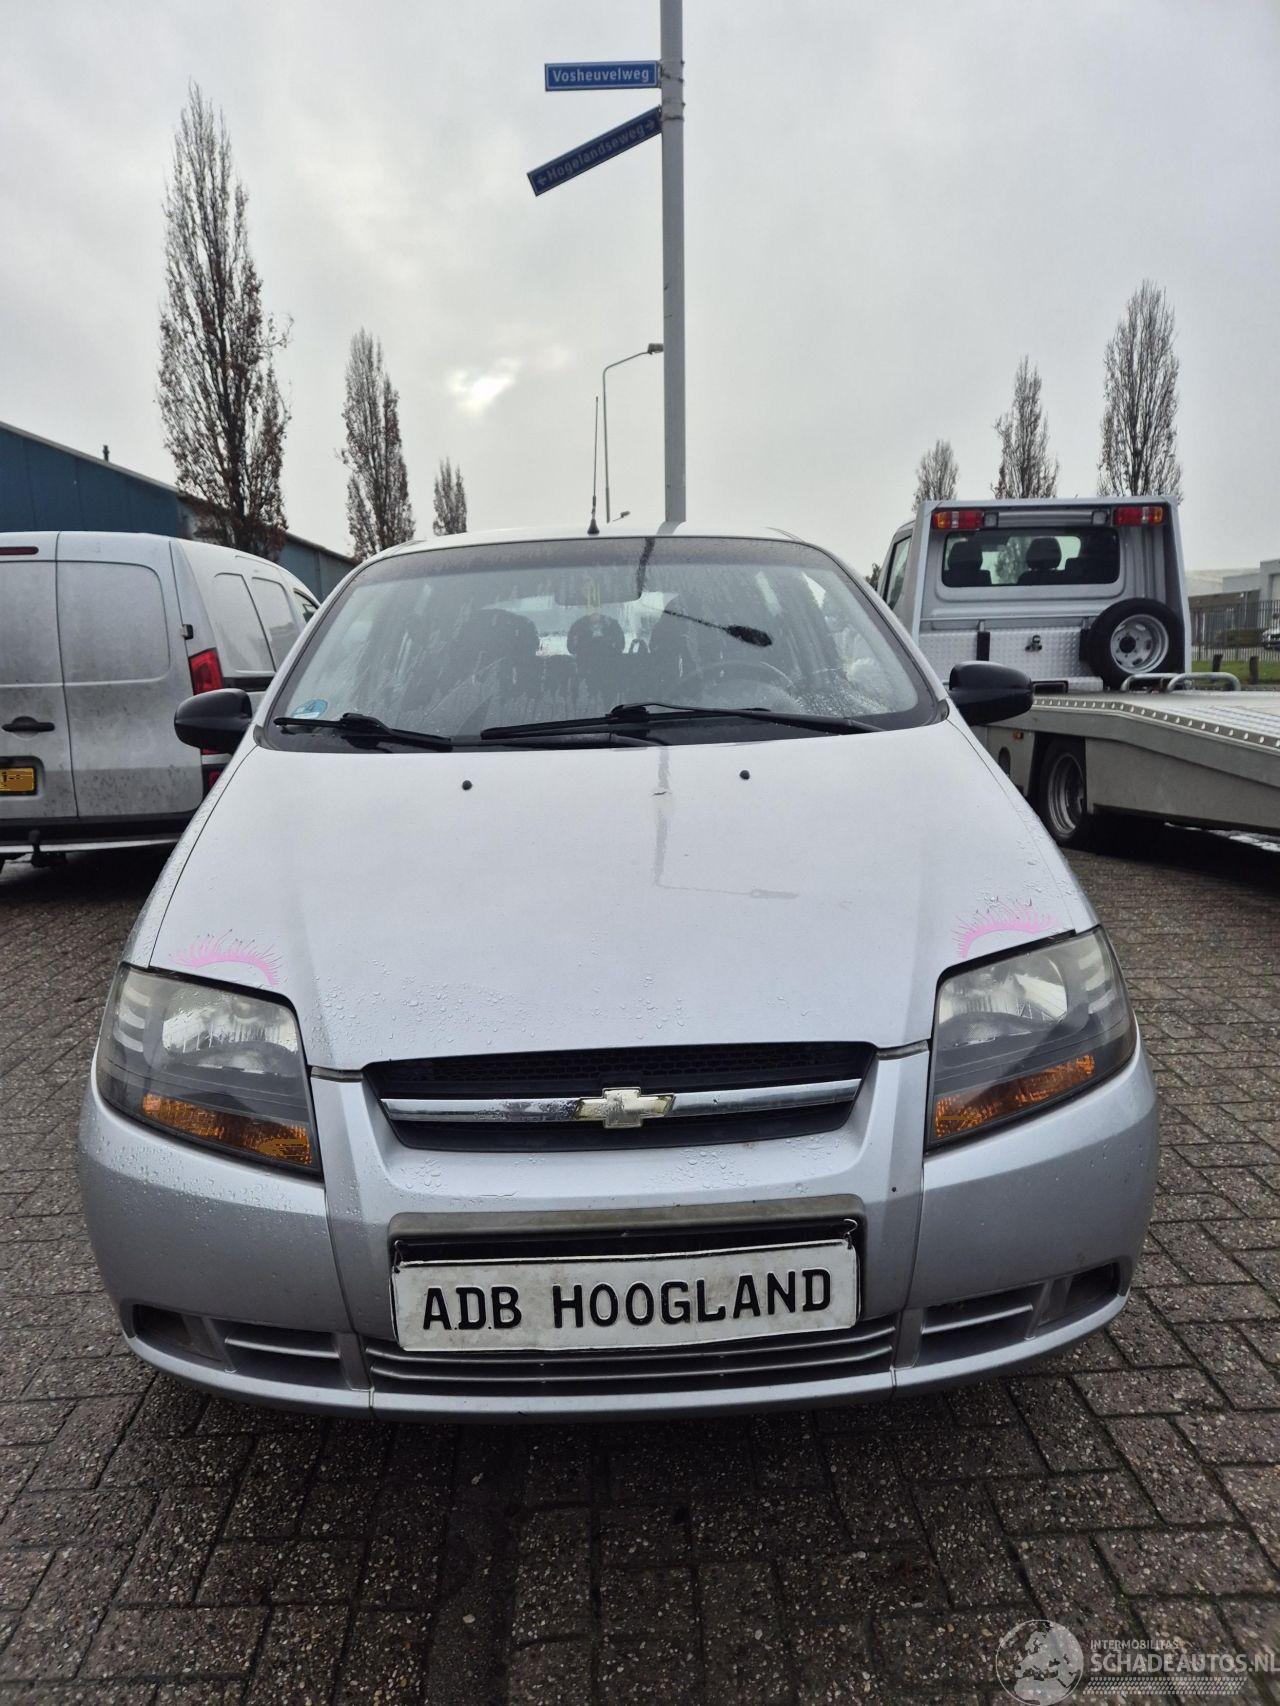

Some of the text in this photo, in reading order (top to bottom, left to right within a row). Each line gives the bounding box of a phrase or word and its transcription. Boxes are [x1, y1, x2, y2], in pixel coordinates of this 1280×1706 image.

[552, 68, 649, 82] Vosheuvelweg
[547, 125, 645, 180] Hogelandseweg
[552, 1269, 831, 1328] HOOGLAND
